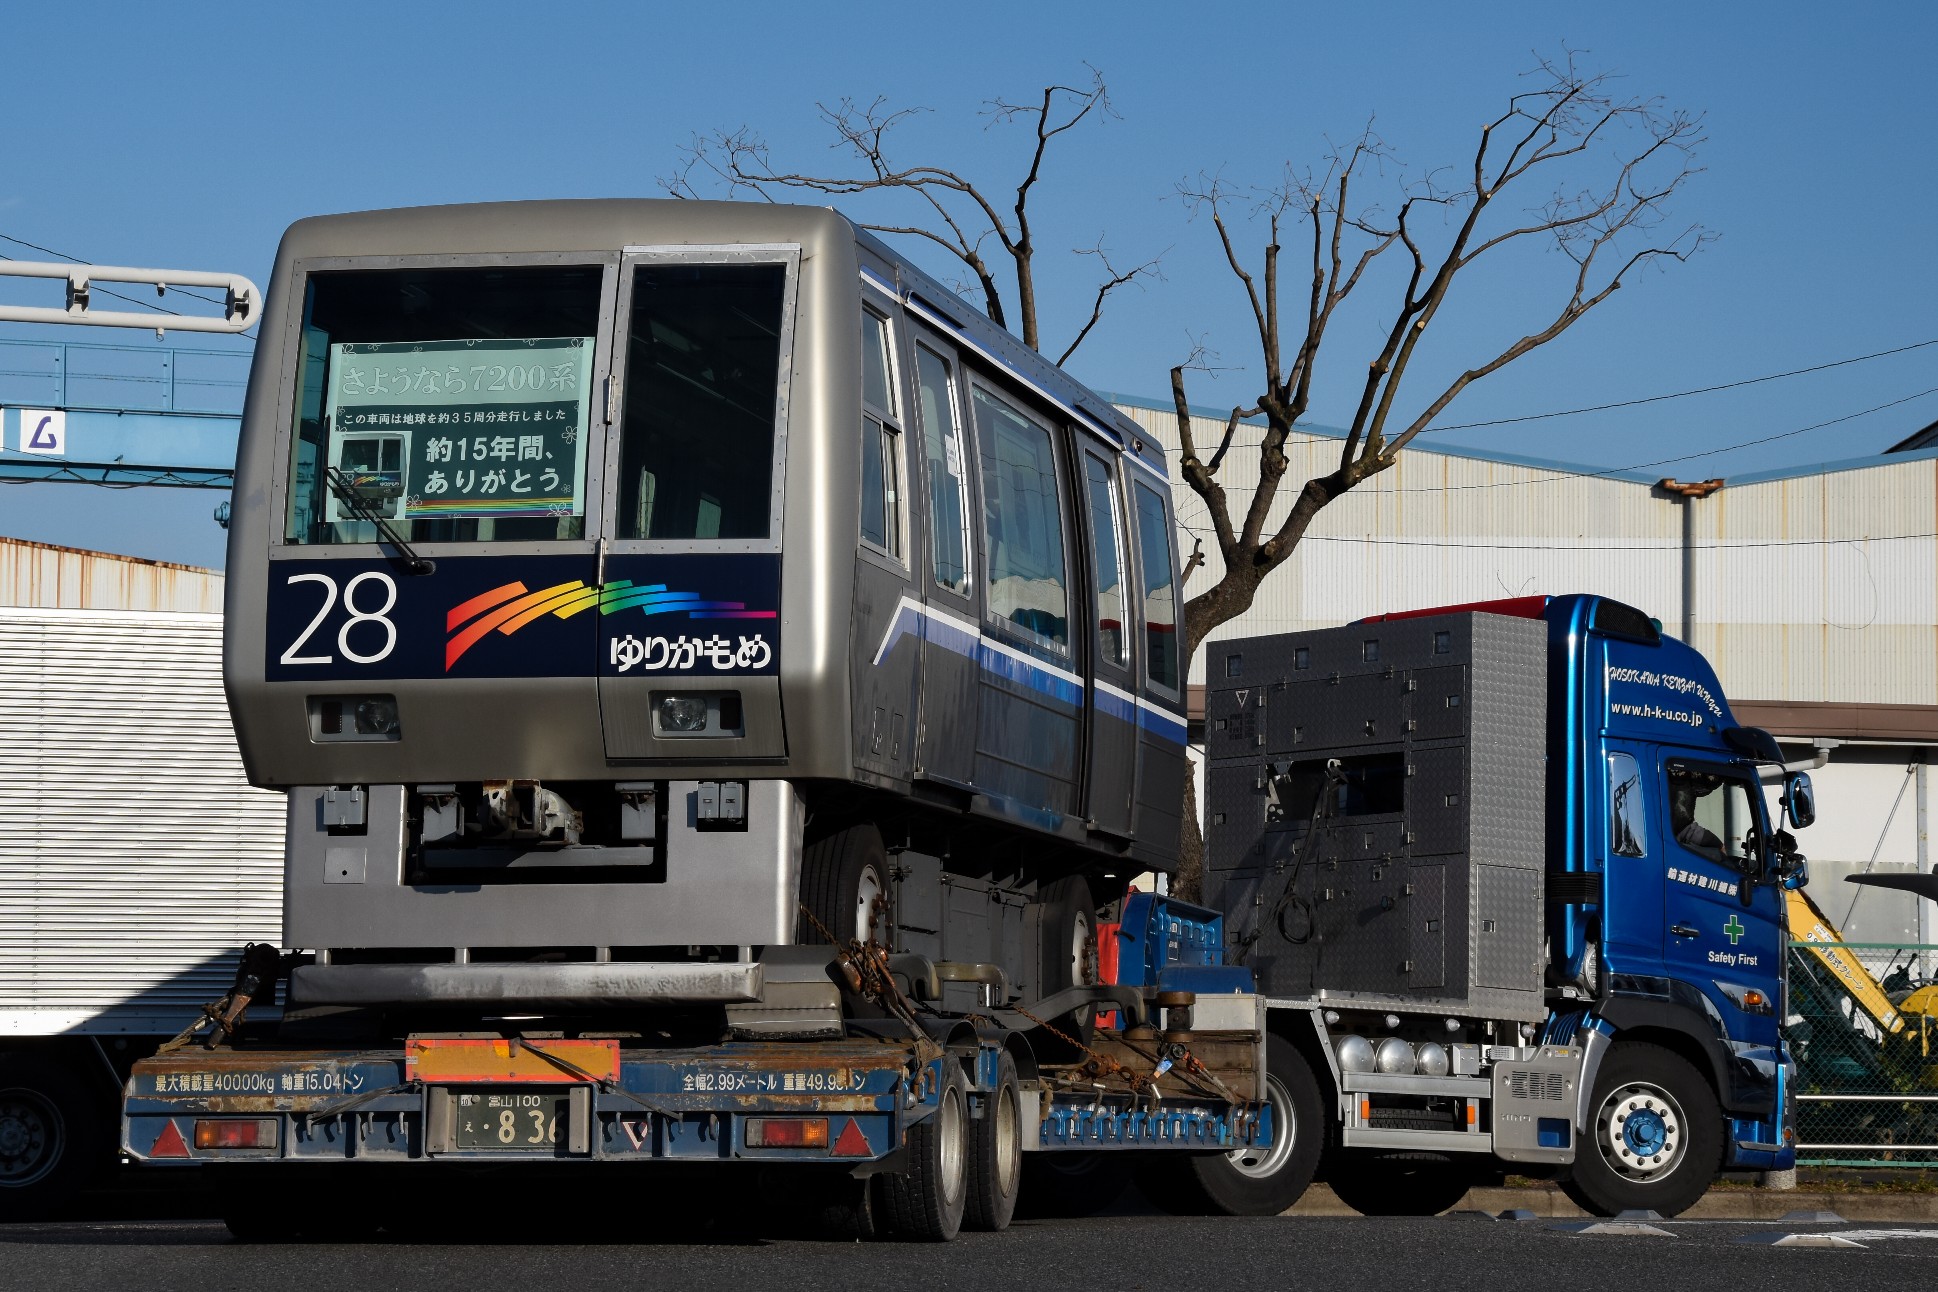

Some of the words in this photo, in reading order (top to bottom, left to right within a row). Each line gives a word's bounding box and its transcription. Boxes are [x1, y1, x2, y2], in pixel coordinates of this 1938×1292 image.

[342, 361, 576, 395] さようなら7200系
[426, 435, 555, 462] 約15年間、
[424, 467, 560, 494] ありがとう
[280, 571, 397, 665] 28
[610, 634, 771, 673] ゆりかもめ
[1609, 666, 1660, 687] HOSOKAWA
[1611, 703, 1703, 727] www.h-k-u.co.jp
[1708, 950, 1736, 967] Safety
[1738, 951, 1758, 967] First
[155, 1073, 275, 1093] 最大積載量40000kg
[281, 1073, 364, 1092] 軸重15.04トン
[683, 1073, 777, 1092] 全幅2.99メートル
[783, 1073, 866, 1092] 重量49.9ン
[488, 1095, 513, 1108] 富山
[516, 1095, 541, 1107] 100
